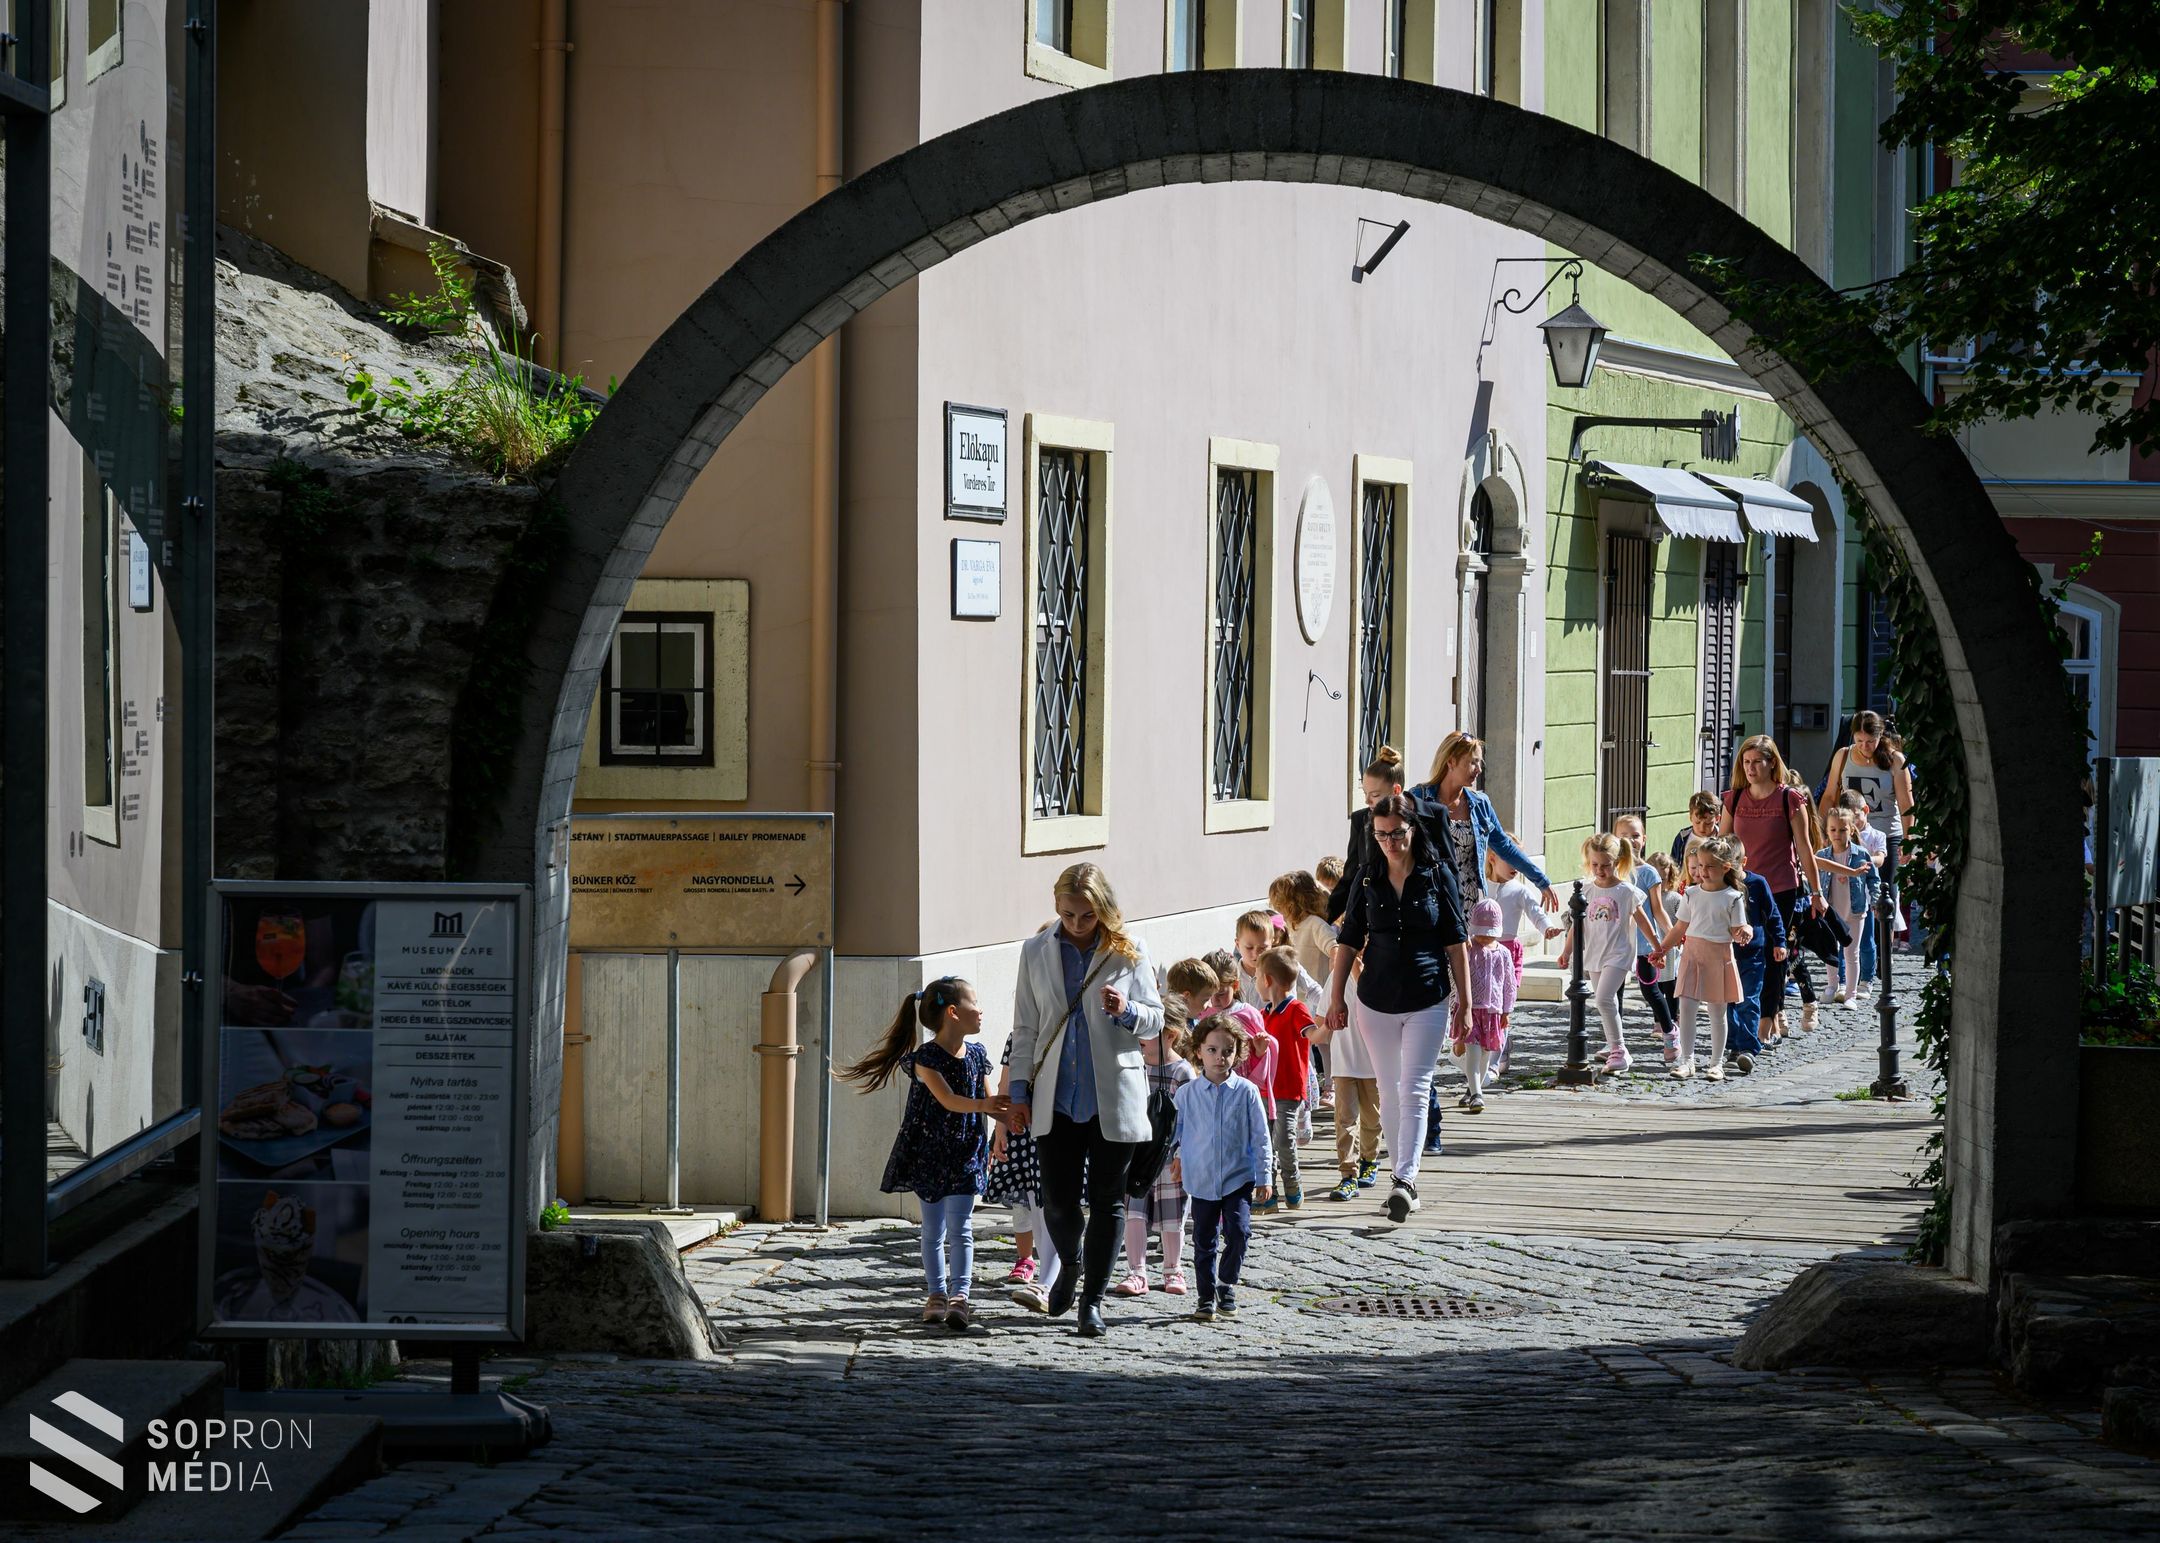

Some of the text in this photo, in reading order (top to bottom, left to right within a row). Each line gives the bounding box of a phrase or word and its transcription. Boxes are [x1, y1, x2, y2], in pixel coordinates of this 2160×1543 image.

[569, 831, 605, 842] SÉTÁNY
[614, 832, 710, 842] STADTMAUERPASSAGE
[719, 832, 749, 841] BAILEY
[752, 832, 807, 842] PROMENADE
[572, 874, 613, 885] BÜNKER
[692, 876, 774, 885] NAGYRONDELLA
[402, 946, 494, 956] MUSEUM CAFE
[387, 981, 412, 990] KÁVÉ
[422, 998, 472, 1008] KOKTÉLOK
[380, 1015, 408, 1024] HIDEG
[410, 1014, 421, 1024] ÉS
[416, 1051, 475, 1061] DESSZERTEK
[410, 1076, 444, 1089] Nyitva
[400, 1227, 481, 1241] Opening hours
